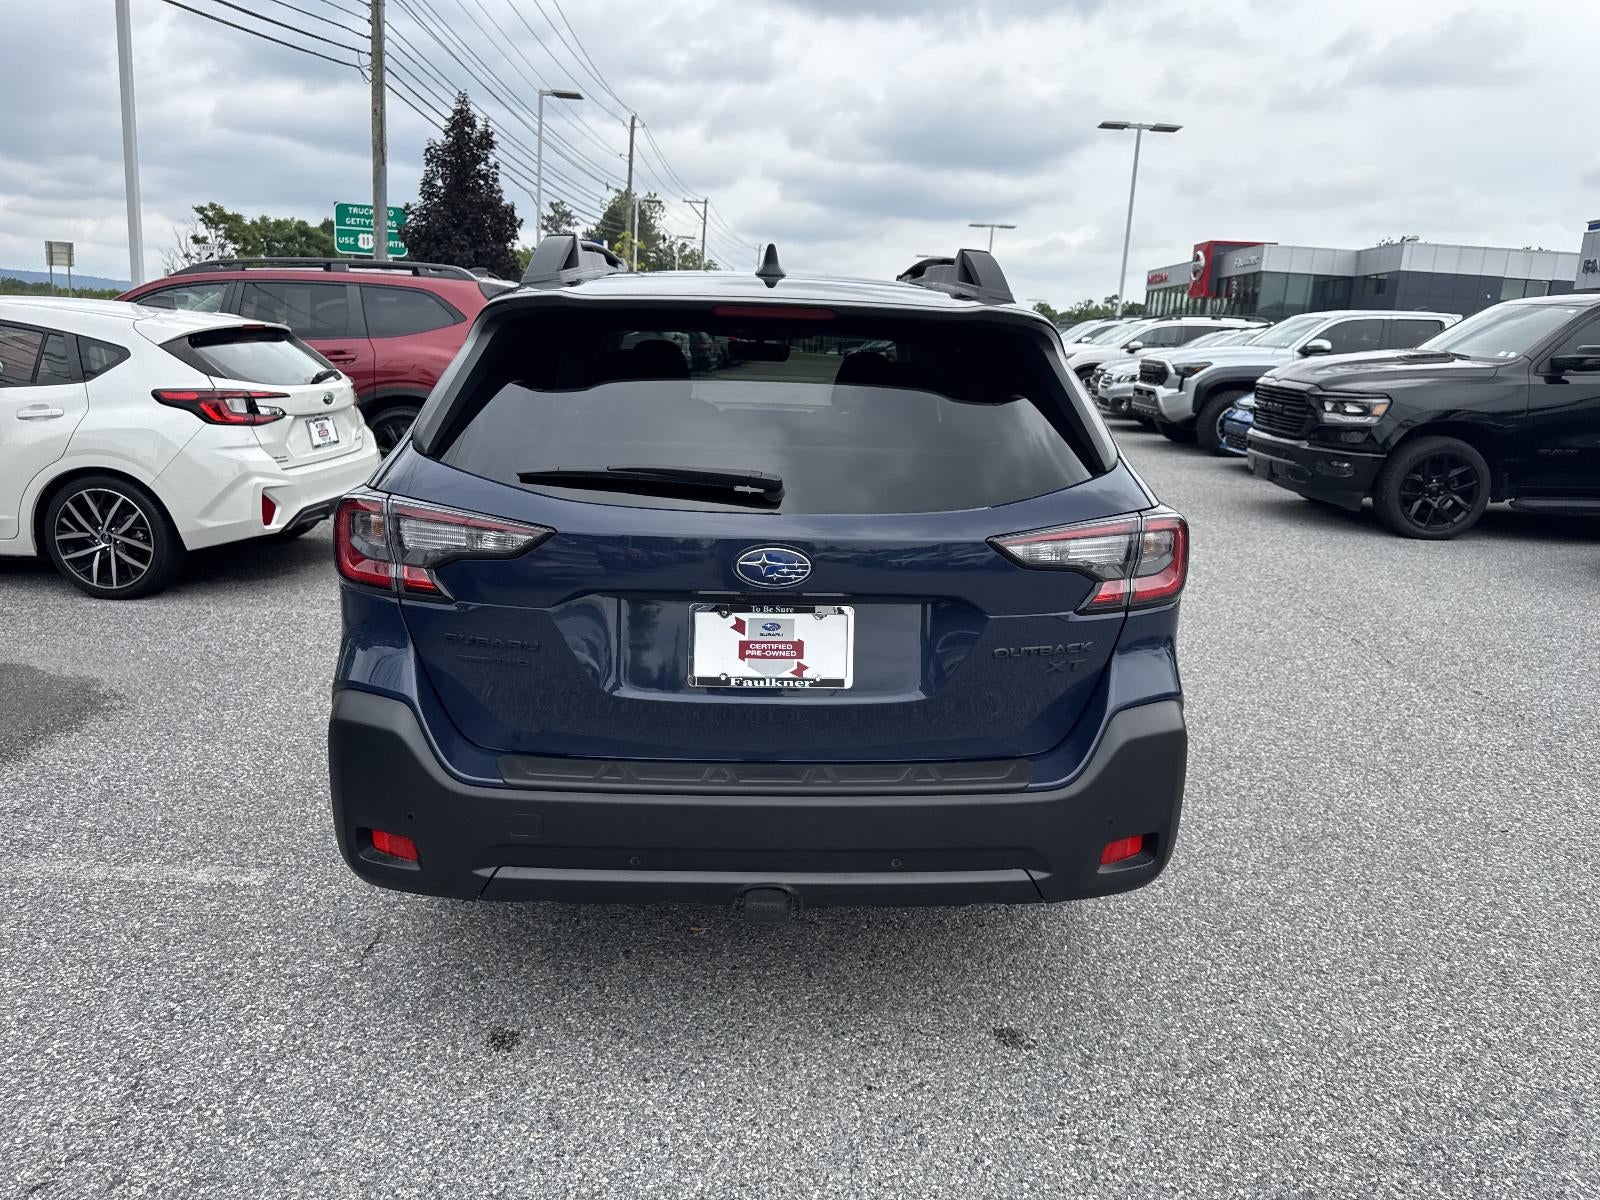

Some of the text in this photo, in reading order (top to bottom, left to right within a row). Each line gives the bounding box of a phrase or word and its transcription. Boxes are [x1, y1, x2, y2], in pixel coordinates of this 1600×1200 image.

[338, 236, 355, 245] USE
[362, 236, 370, 247] 11
[751, 605, 795, 614] To Be Sure
[992, 641, 1095, 658] OUTBACK
[1042, 658, 1088, 675] XT
[730, 677, 814, 688] Faulkner
